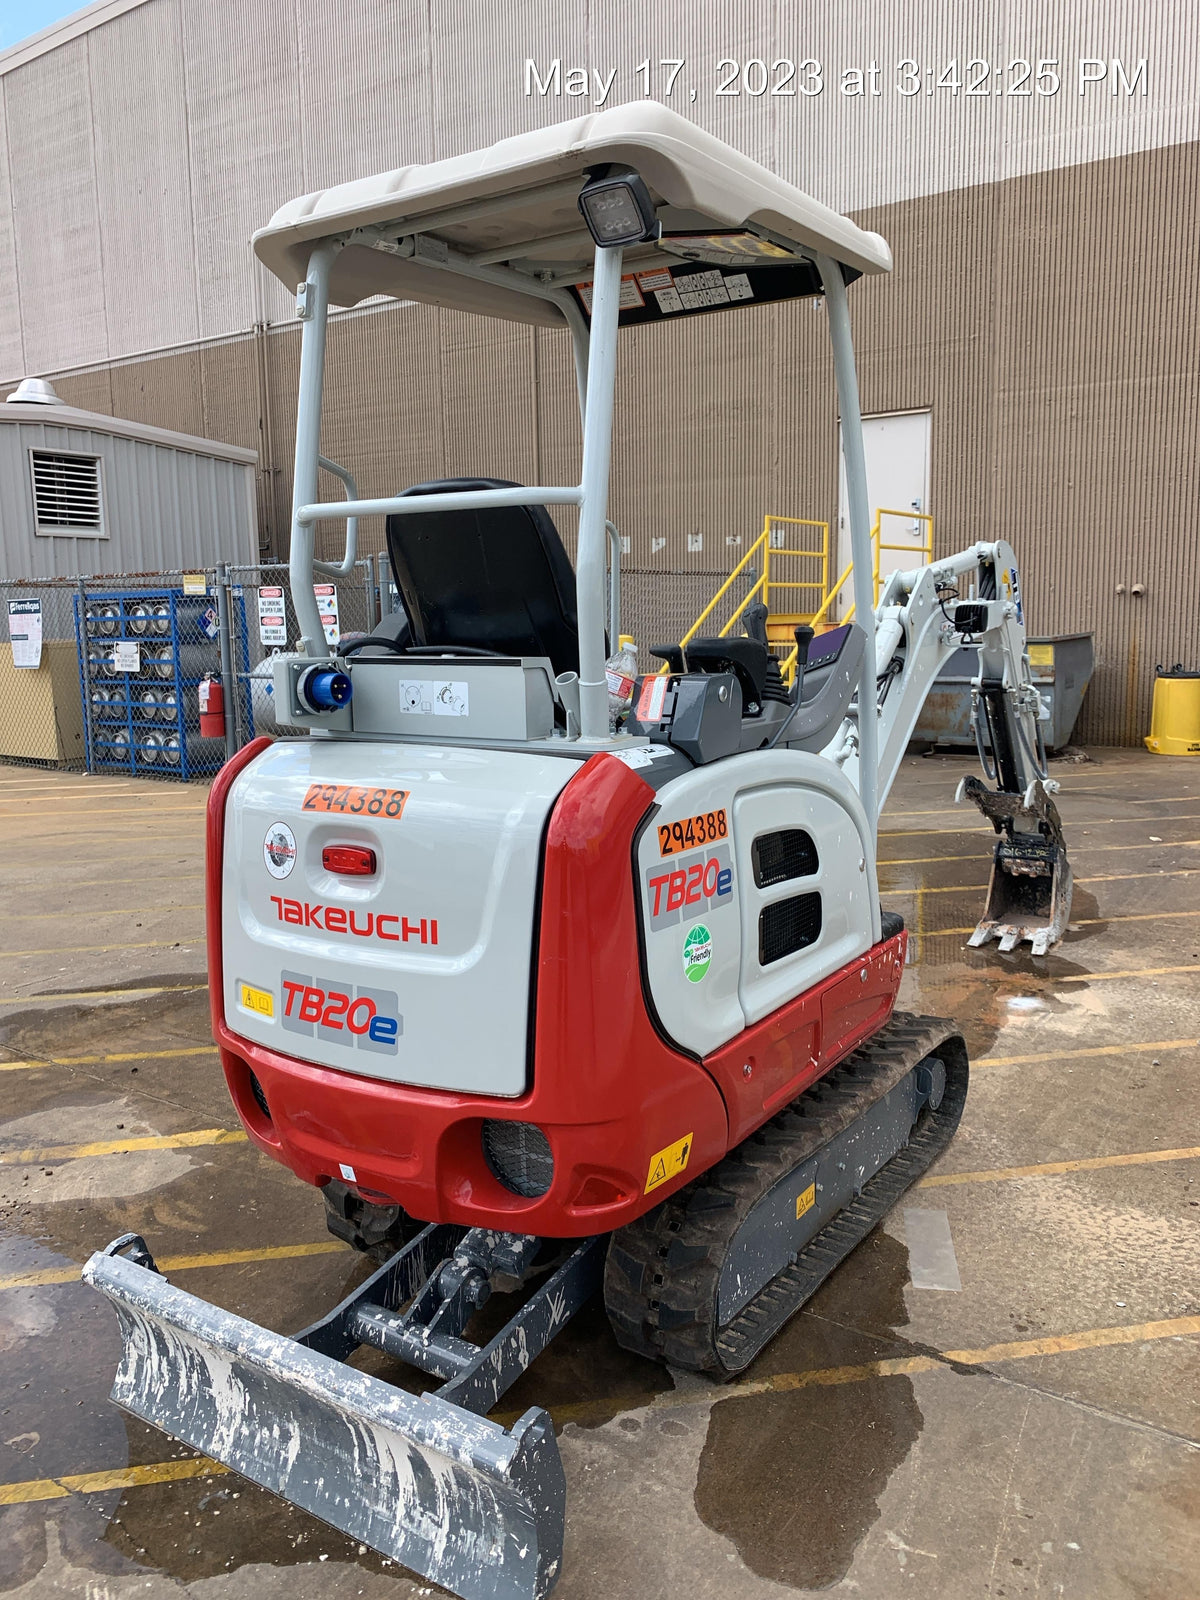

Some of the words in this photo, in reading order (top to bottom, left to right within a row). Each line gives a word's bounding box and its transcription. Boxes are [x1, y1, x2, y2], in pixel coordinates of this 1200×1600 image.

[304, 784, 405, 818] 294388
[660, 808, 727, 855] 294388
[648, 856, 732, 918] TB20e
[282, 980, 399, 1046] TB20e
